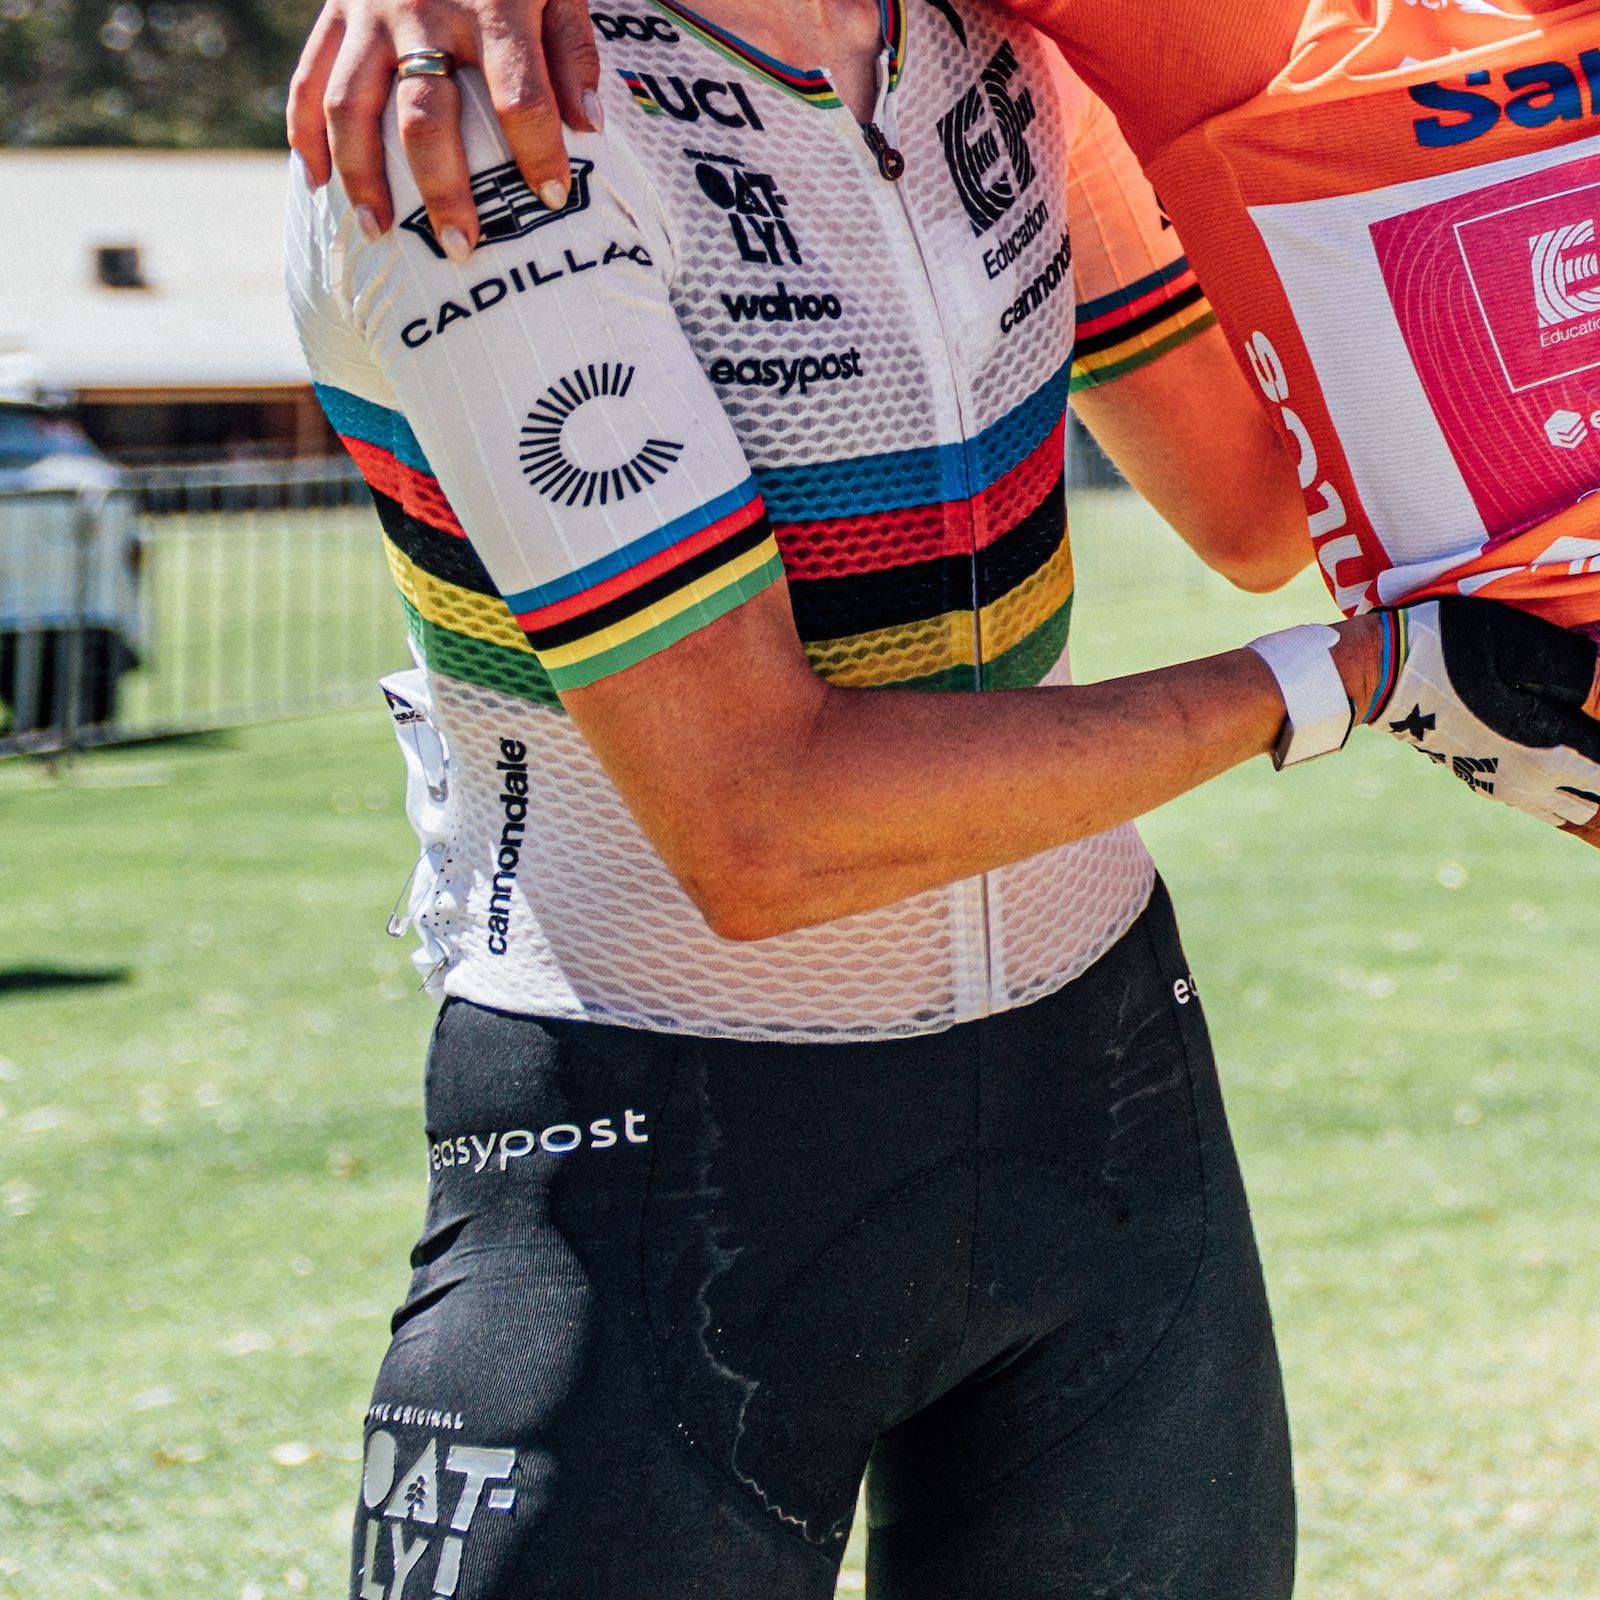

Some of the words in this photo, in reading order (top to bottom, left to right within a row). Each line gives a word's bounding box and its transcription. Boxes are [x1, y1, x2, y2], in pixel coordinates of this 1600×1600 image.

[591, 13, 680, 43] poc
[638, 72, 764, 131] UCI
[728, 213, 802, 266] LY!
[983, 200, 1049, 280] Education
[720, 282, 841, 322] wahoo
[710, 347, 863, 395] easypost
[488, 738, 528, 955] cannondale
[431, 1109, 649, 1174] easypost
[392, 1406, 464, 1430] ORIGINAL
